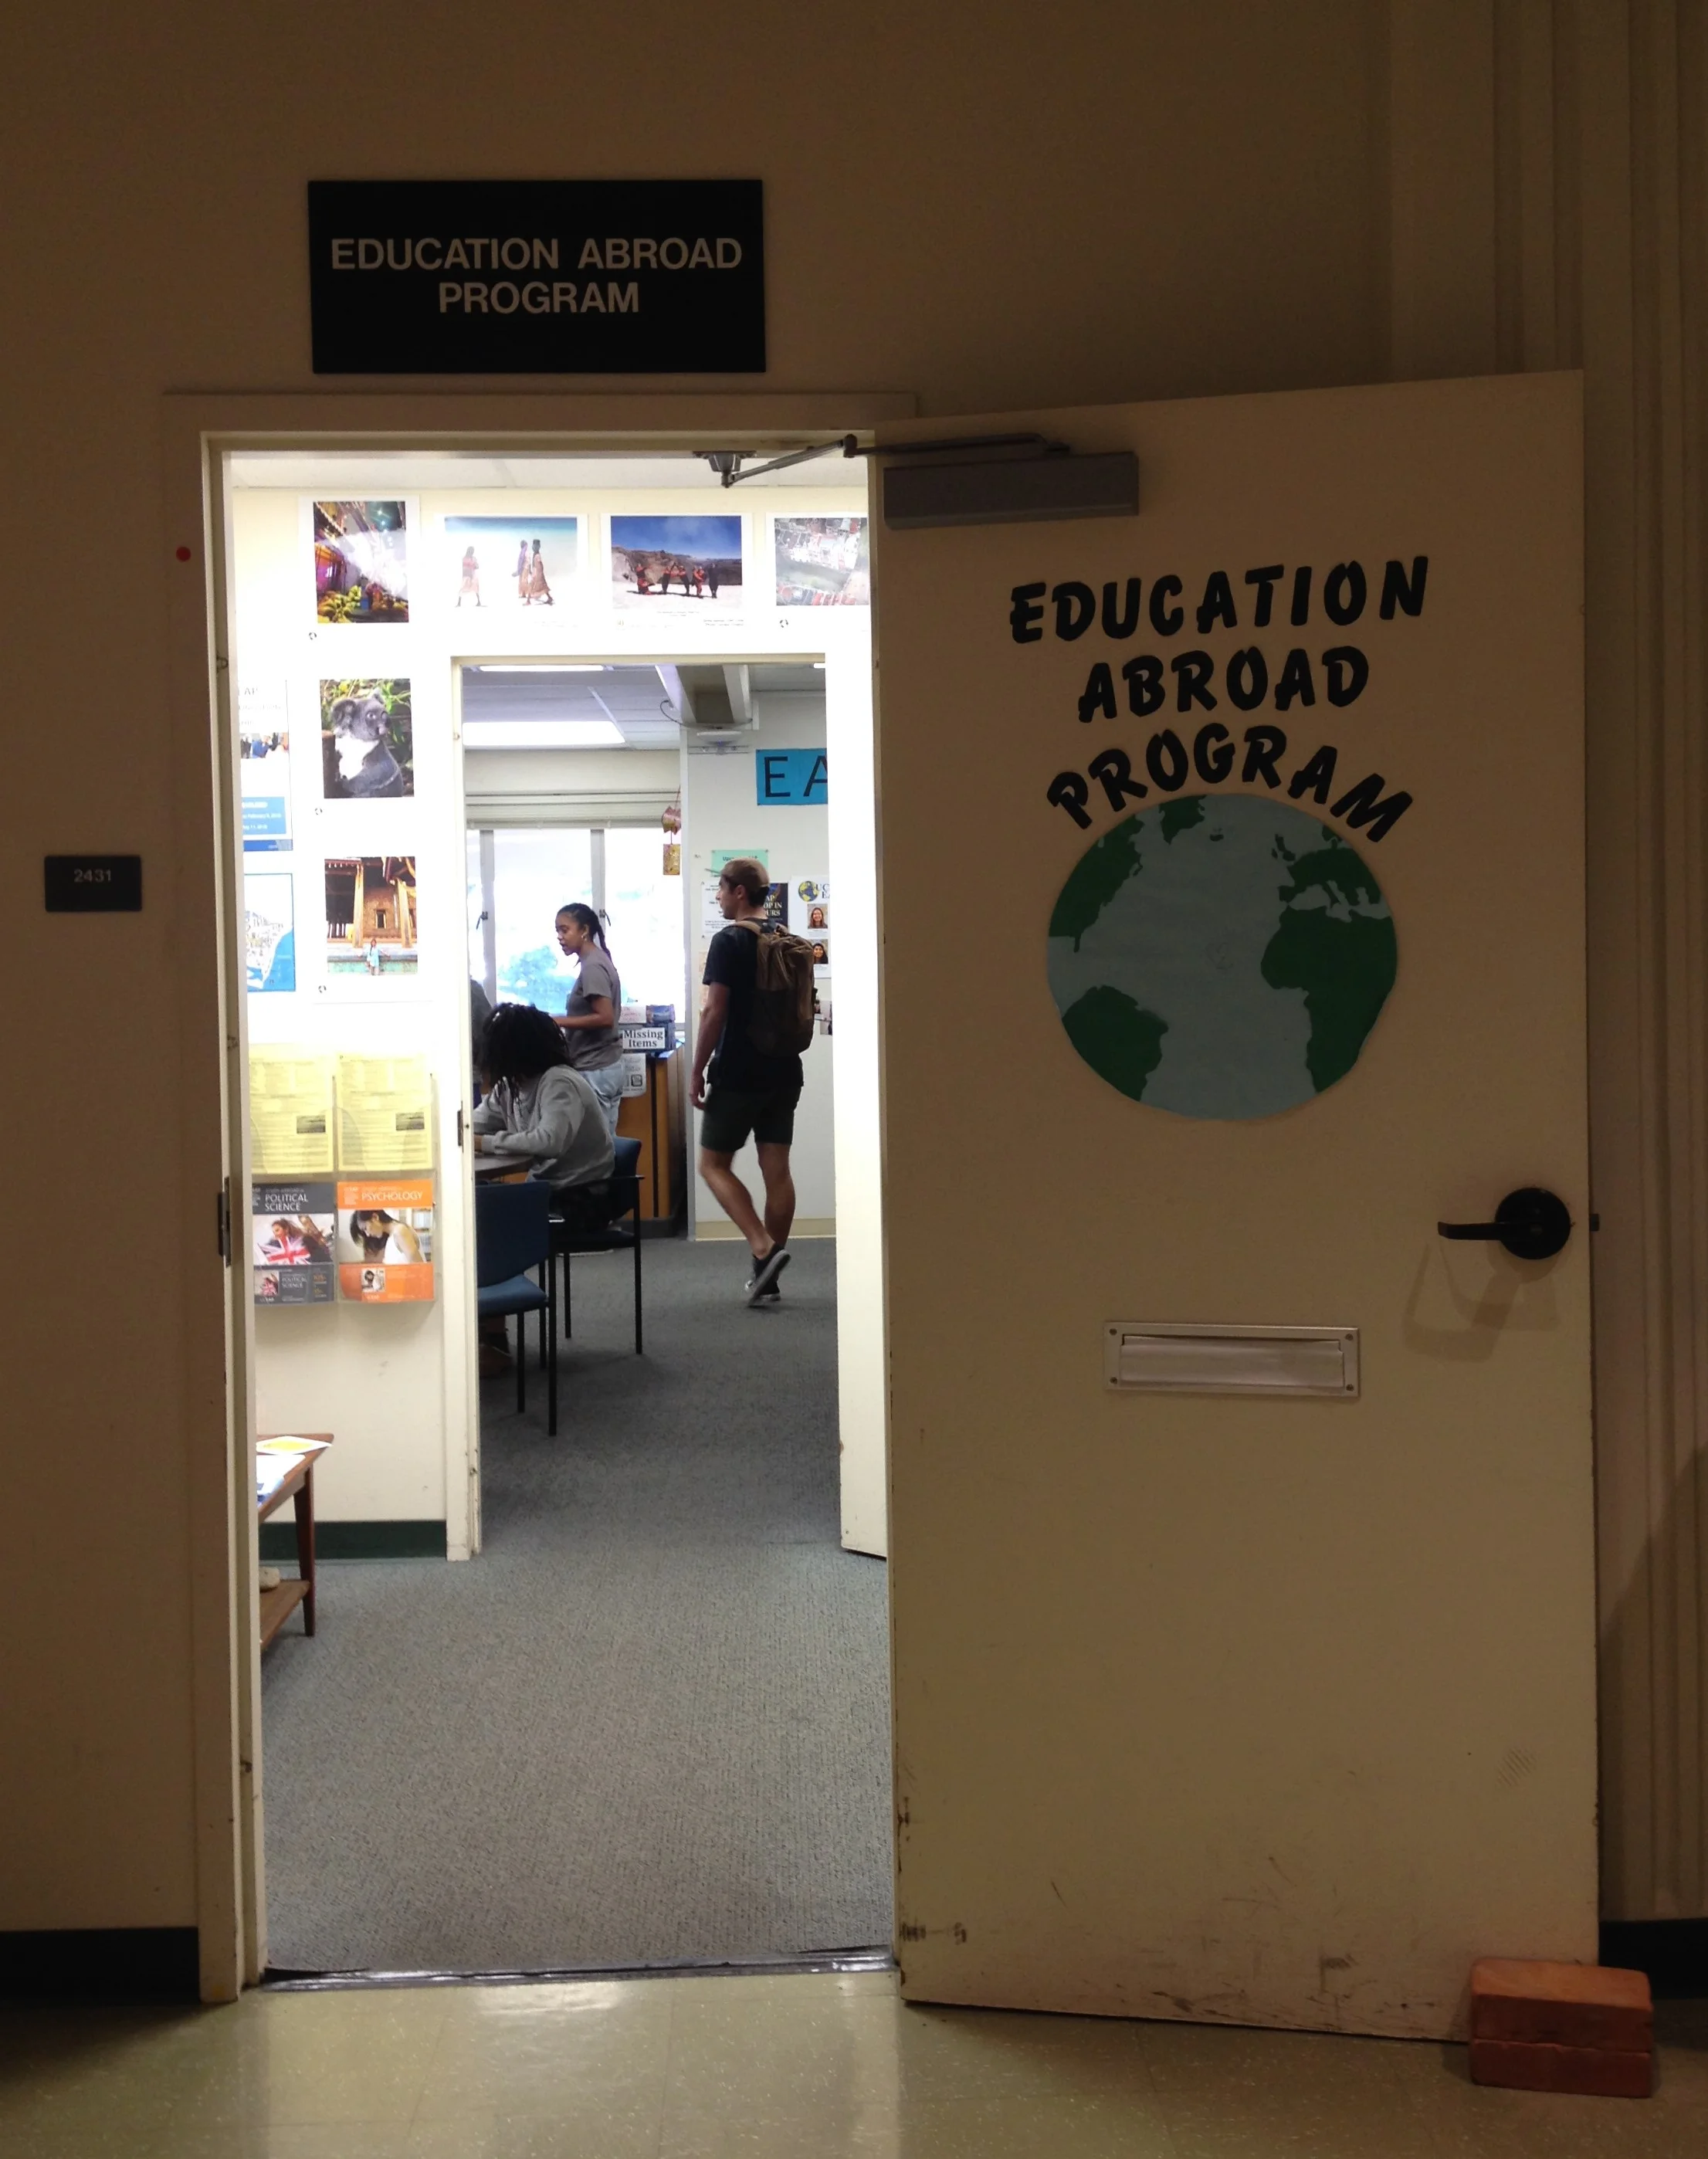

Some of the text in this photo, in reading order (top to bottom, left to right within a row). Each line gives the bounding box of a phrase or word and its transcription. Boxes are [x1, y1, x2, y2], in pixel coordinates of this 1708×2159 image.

[331, 237, 743, 269] EDUCATION ABROAD
[439, 282, 639, 314] PROGRAM
[1009, 556, 1428, 644] EDUCATION
[1078, 646, 1369, 723] ABROAD
[1046, 723, 1413, 842] PROGRAM
[74, 868, 111, 883] 2431
[624, 1029, 663, 1040] Missing
[629, 1039, 657, 1048] Items
[265, 1193, 308, 1202] POLITICAL
[361, 1191, 423, 1202] PSYCHOLOGY
[265, 1202, 301, 1212] SCIENCE
